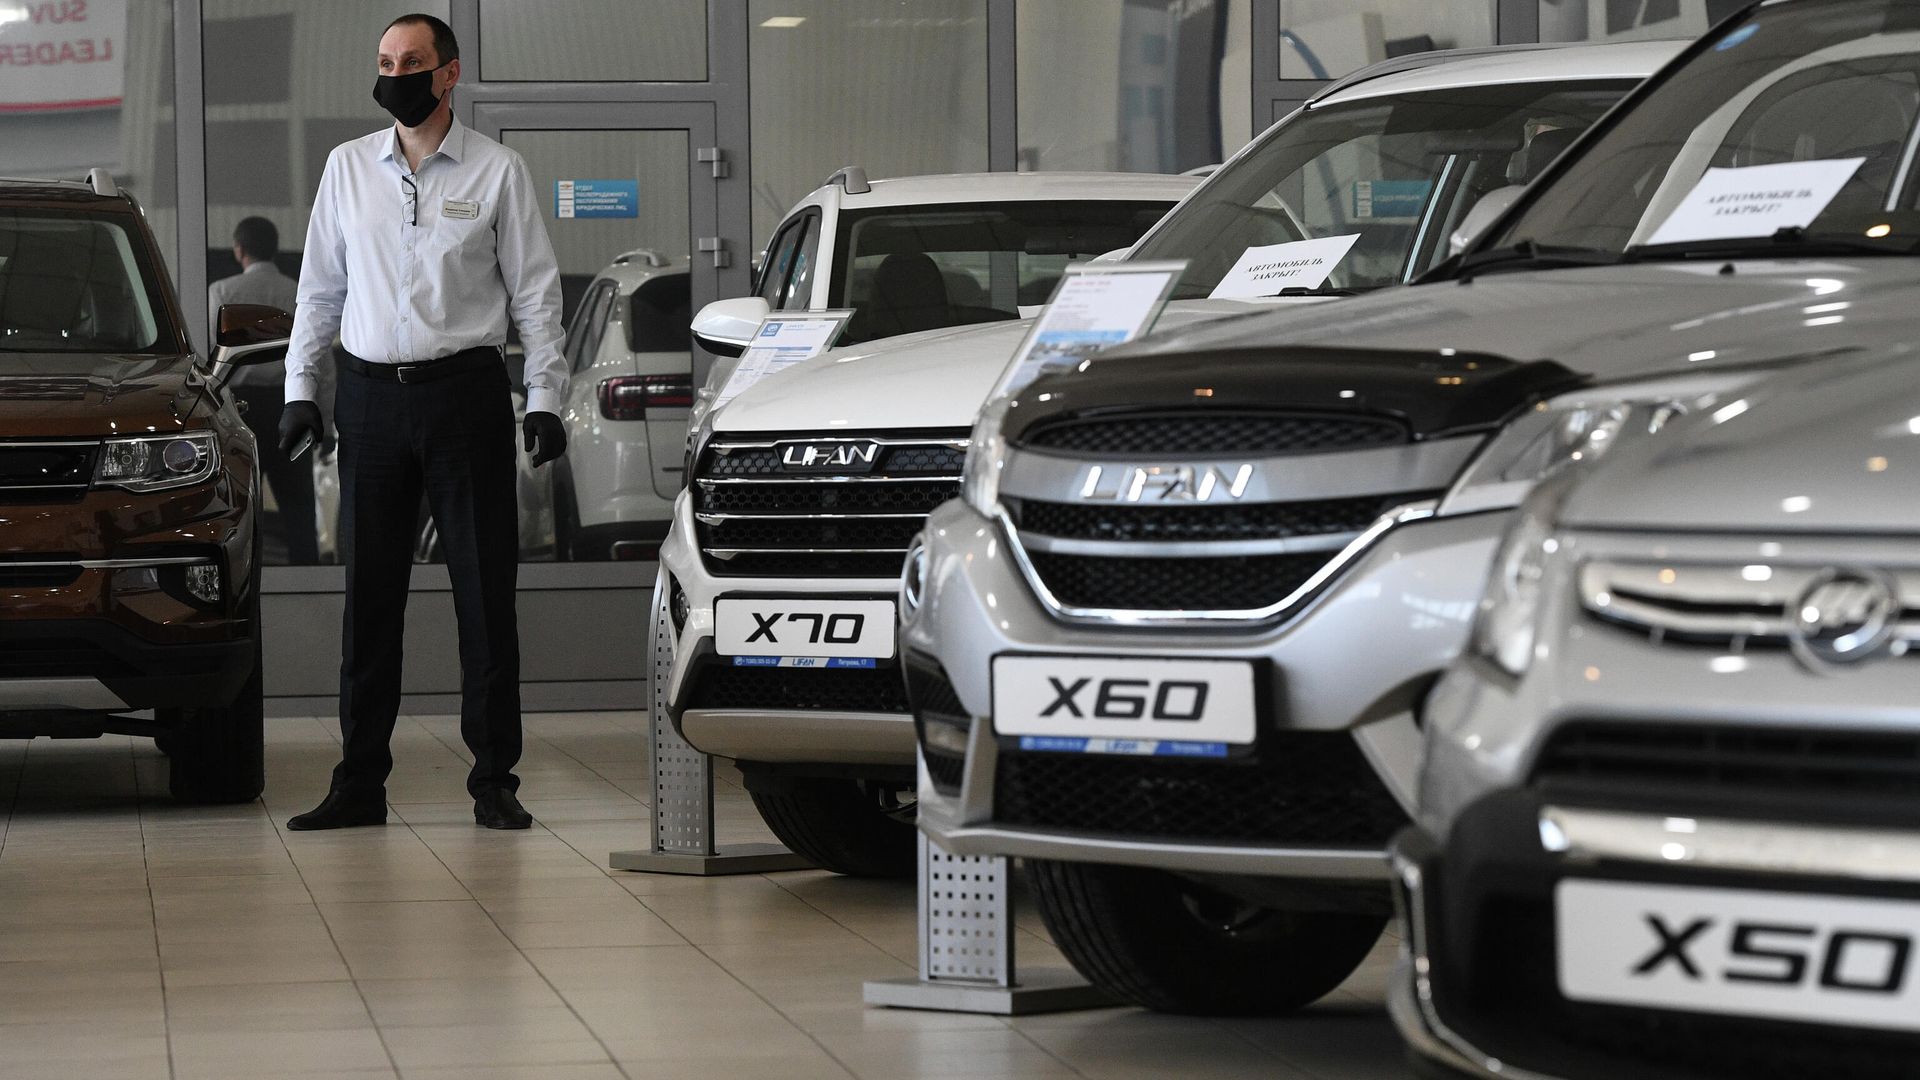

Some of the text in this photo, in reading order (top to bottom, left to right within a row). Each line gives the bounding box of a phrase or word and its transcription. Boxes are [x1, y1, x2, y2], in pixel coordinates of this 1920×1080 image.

[1707, 189, 1813, 205] АВТОМОБИЛЬ
[1246, 257, 1324, 273] АВТОМОБИЛЬ
[1251, 269, 1302, 281] ЗАКРЫТ!
[783, 444, 878, 466] LIFAN
[1080, 464, 1253, 502] LIFAN
[744, 612, 865, 644] X70
[792, 657, 815, 667] LIFAN
[1038, 676, 1209, 721] X60
[1630, 912, 1913, 996] X50
